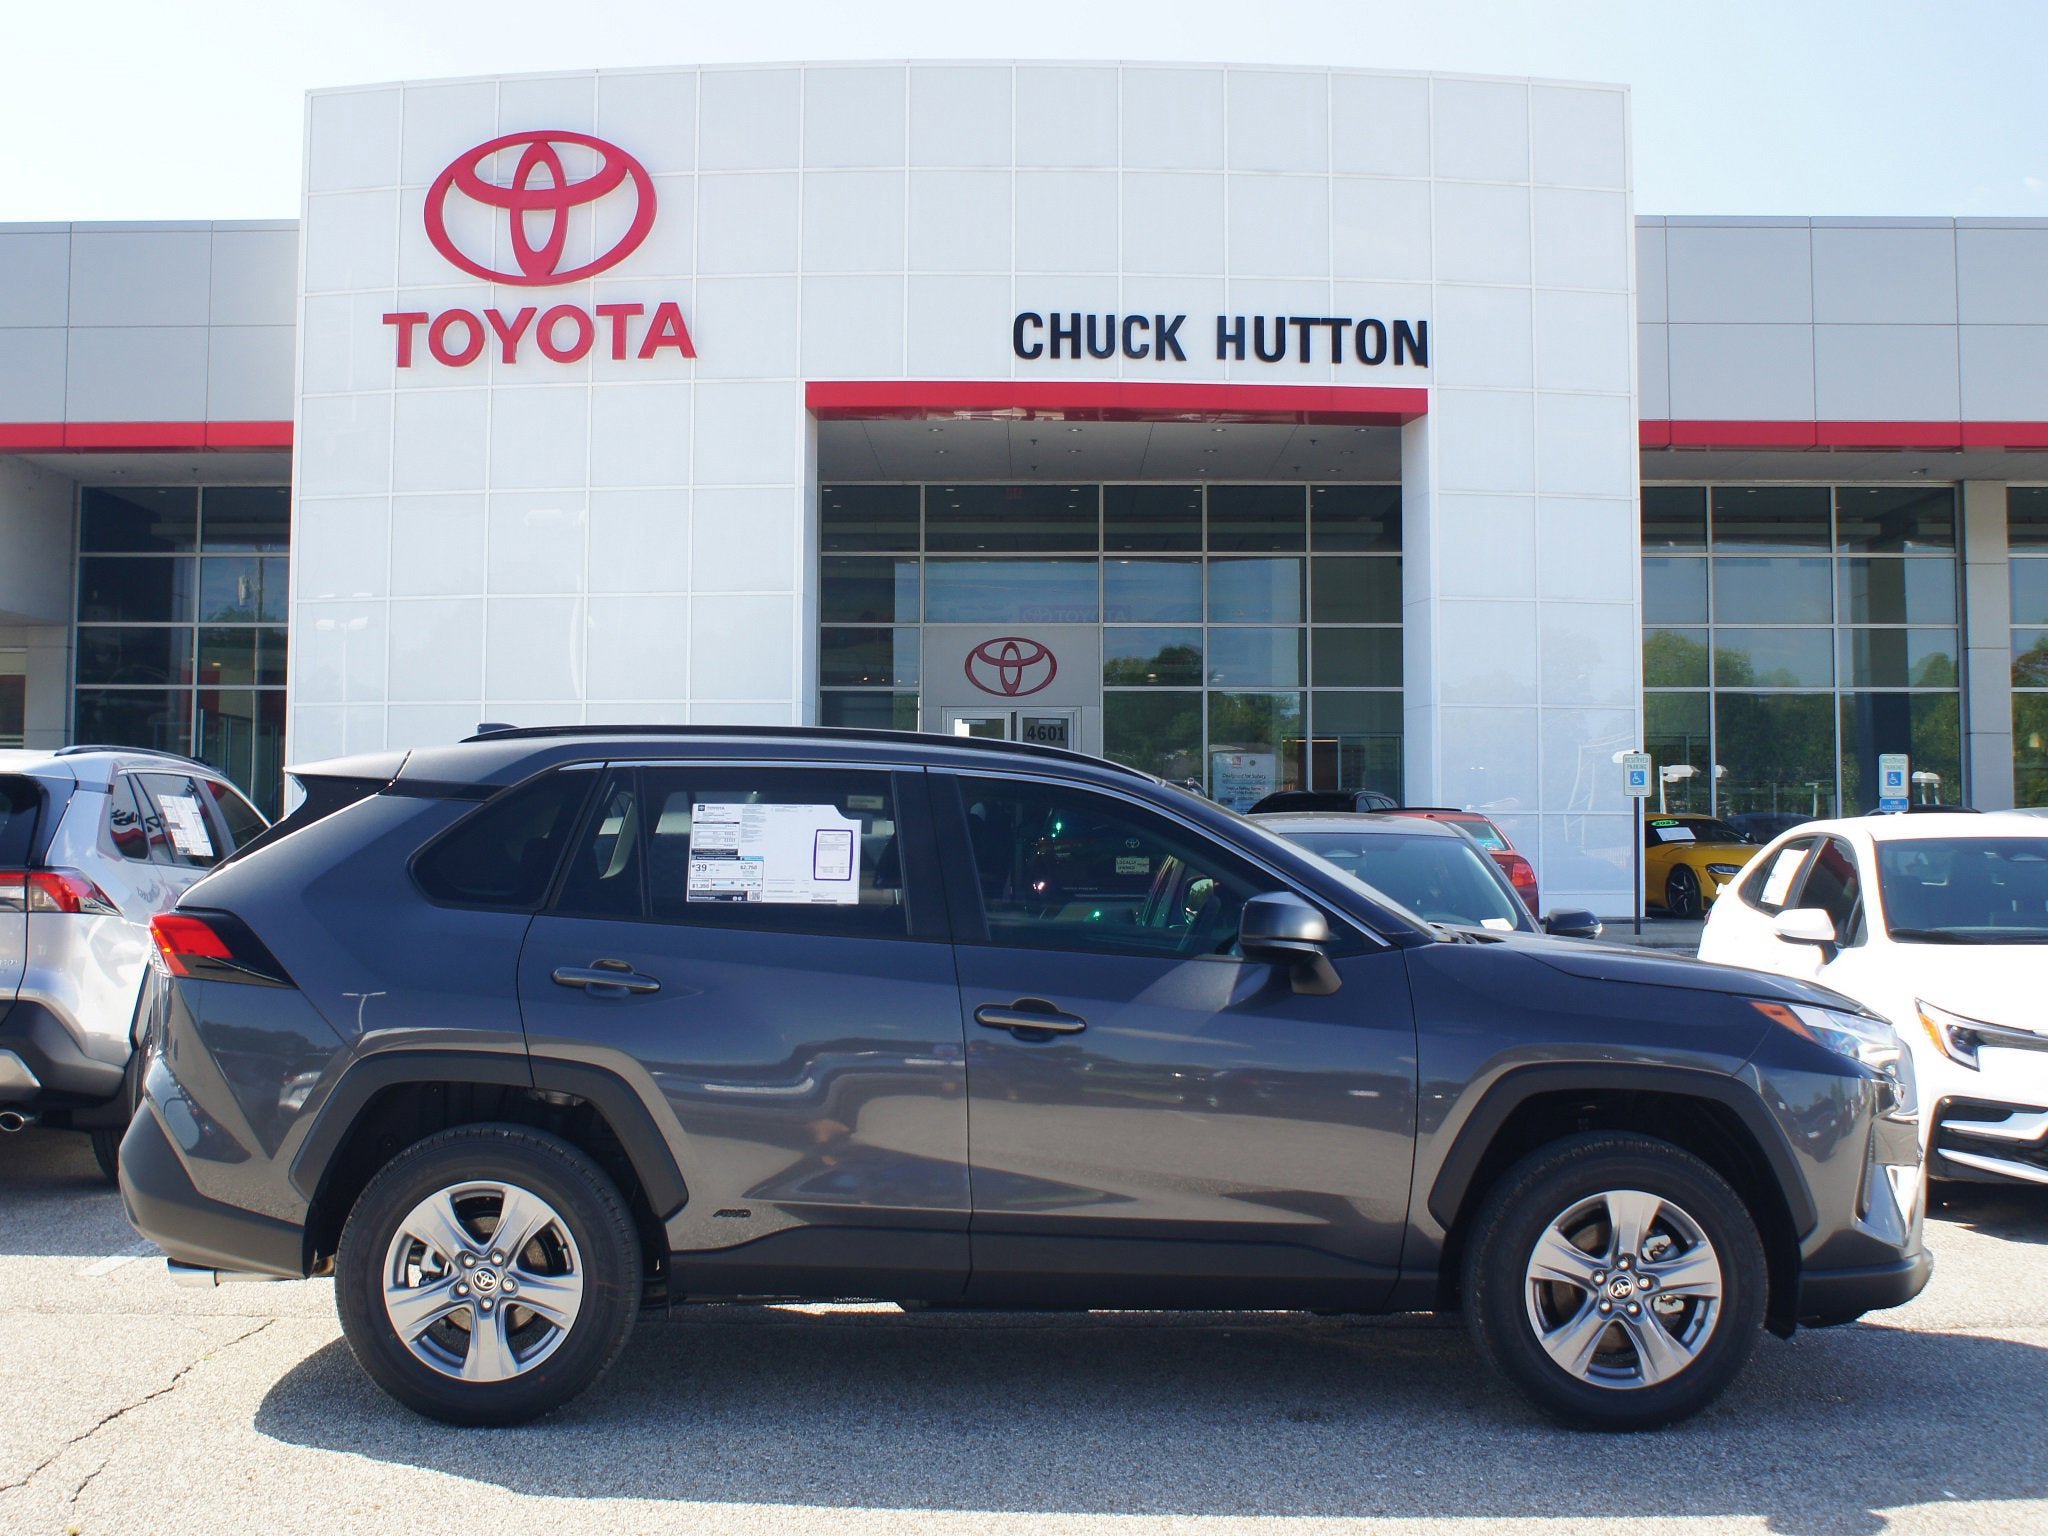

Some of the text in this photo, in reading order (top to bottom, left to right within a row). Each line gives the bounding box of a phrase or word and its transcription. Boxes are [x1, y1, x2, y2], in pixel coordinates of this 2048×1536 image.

[382, 302, 698, 368] TOYOTA
[1013, 312, 1429, 368] CHUCK HUTTON
[1026, 725, 1065, 741] 4601
[695, 864, 707, 872] 39
[713, 1209, 752, 1217] AWD
